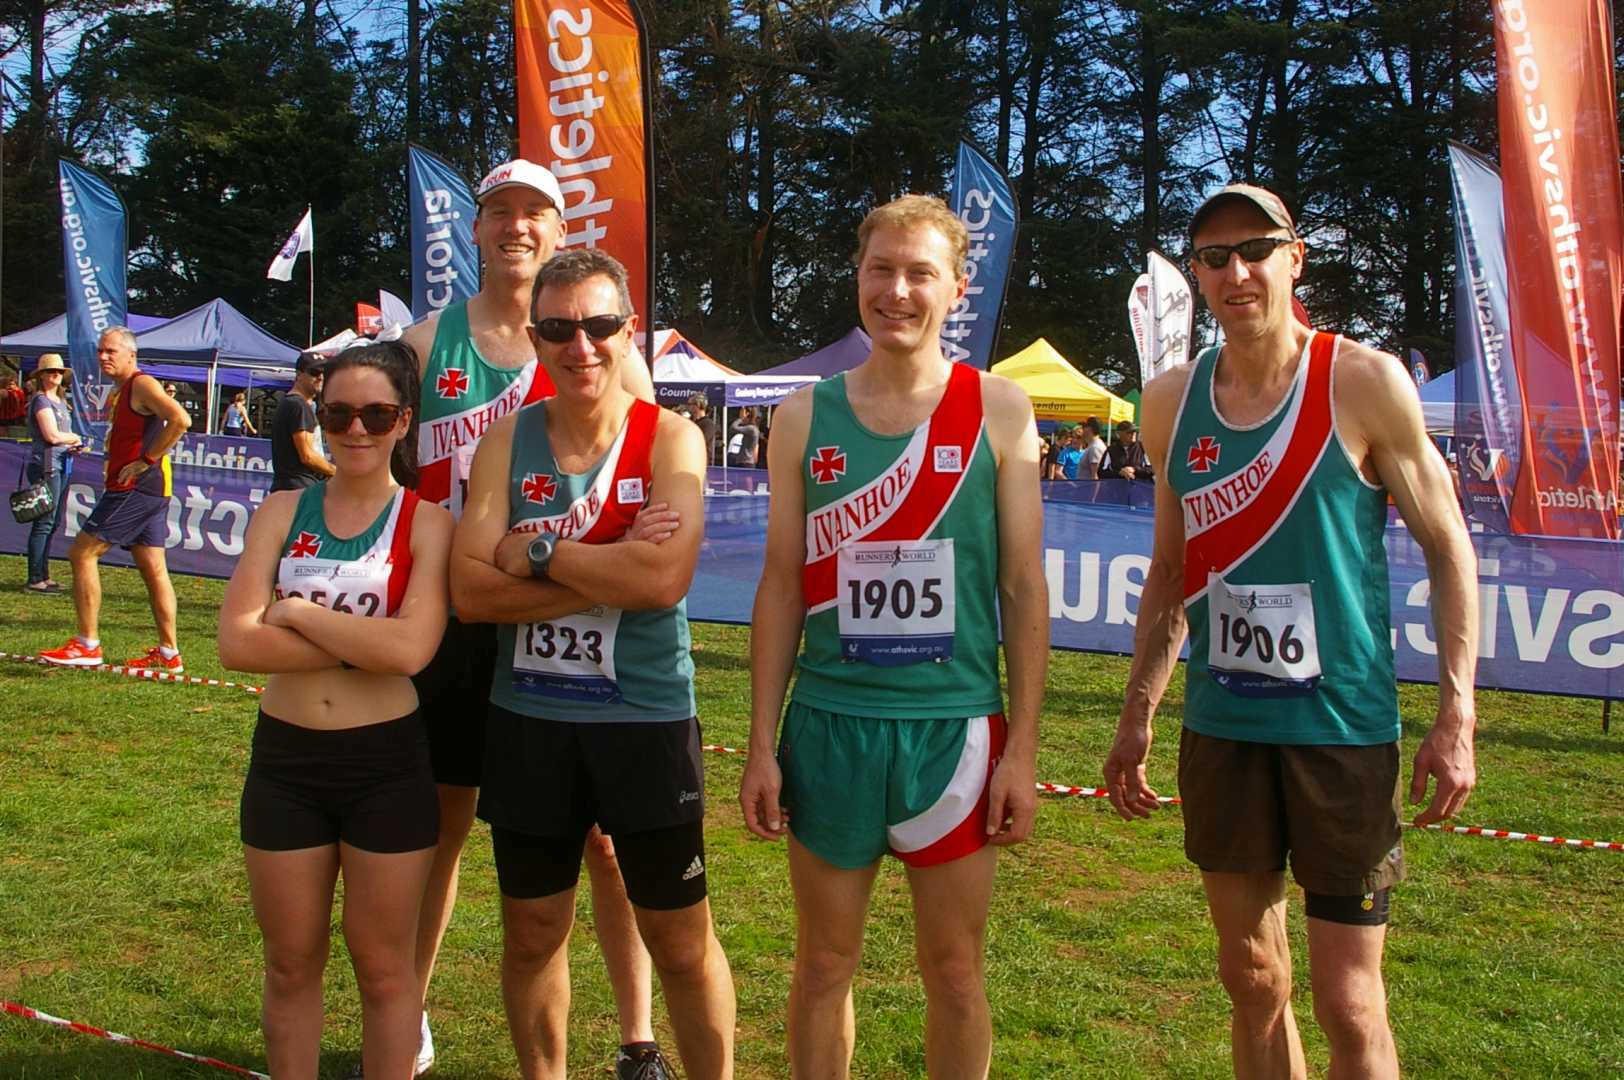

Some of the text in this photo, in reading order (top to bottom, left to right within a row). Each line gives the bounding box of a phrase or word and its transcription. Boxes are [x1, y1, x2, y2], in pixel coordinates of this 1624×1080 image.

[432, 384, 521, 458] IVANHOE
[813, 457, 912, 557] IVANHOE
[1184, 450, 1273, 528] VANHOE
[902, 551, 936, 561] WORLD
[848, 578, 943, 619] 1905
[526, 623, 603, 664] 1323
[1220, 613, 1304, 664] 1906
